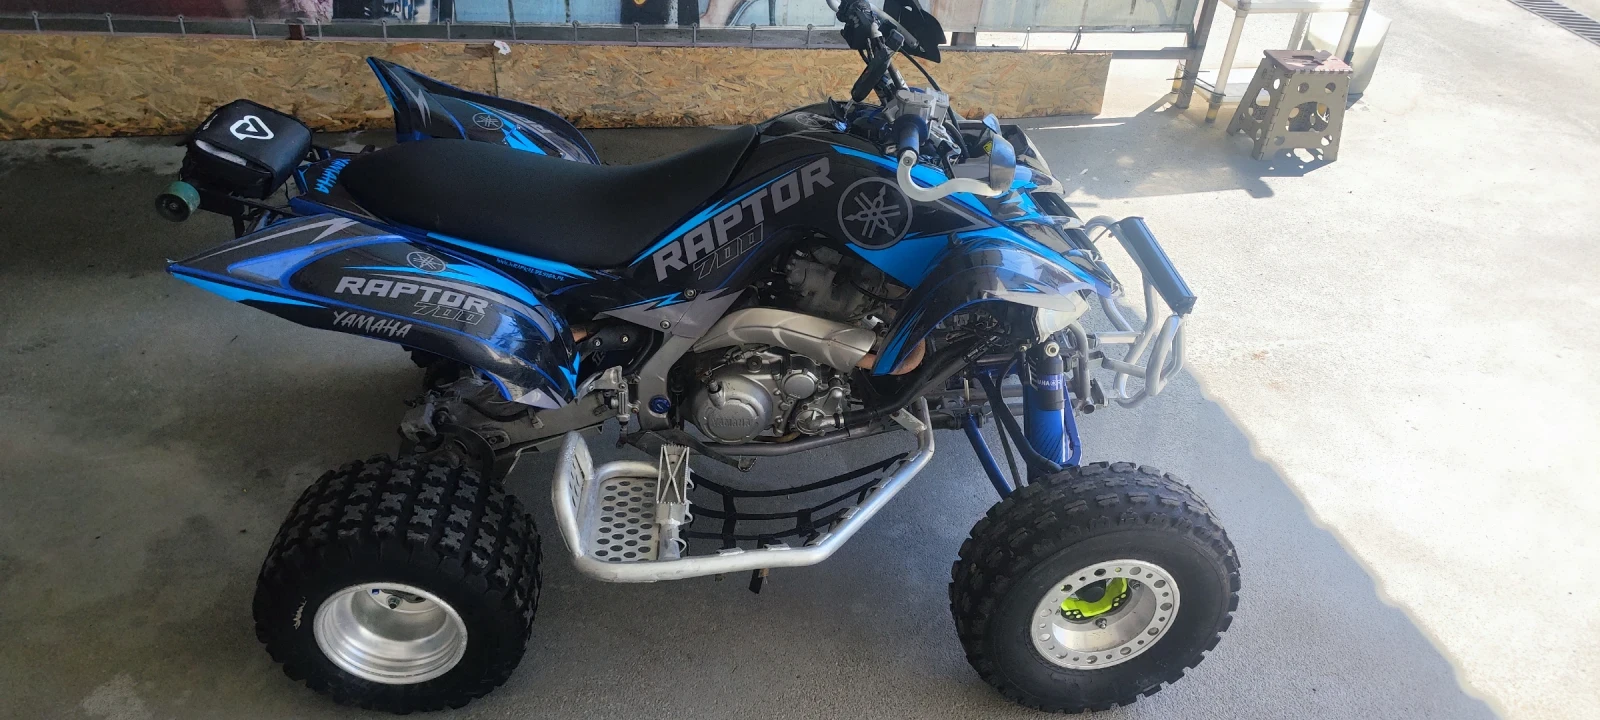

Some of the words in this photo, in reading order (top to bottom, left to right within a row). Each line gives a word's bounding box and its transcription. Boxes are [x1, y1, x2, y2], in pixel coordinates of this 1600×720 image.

[314, 158, 351, 193] YAMAHA
[652, 156, 834, 282] RAPTOR
[693, 222, 764, 280] 700
[334, 276, 489, 314] RAPTOR
[333, 310, 413, 339] YAMAHA
[412, 302, 485, 326] 700
[711, 416, 751, 428] YAMAHA
